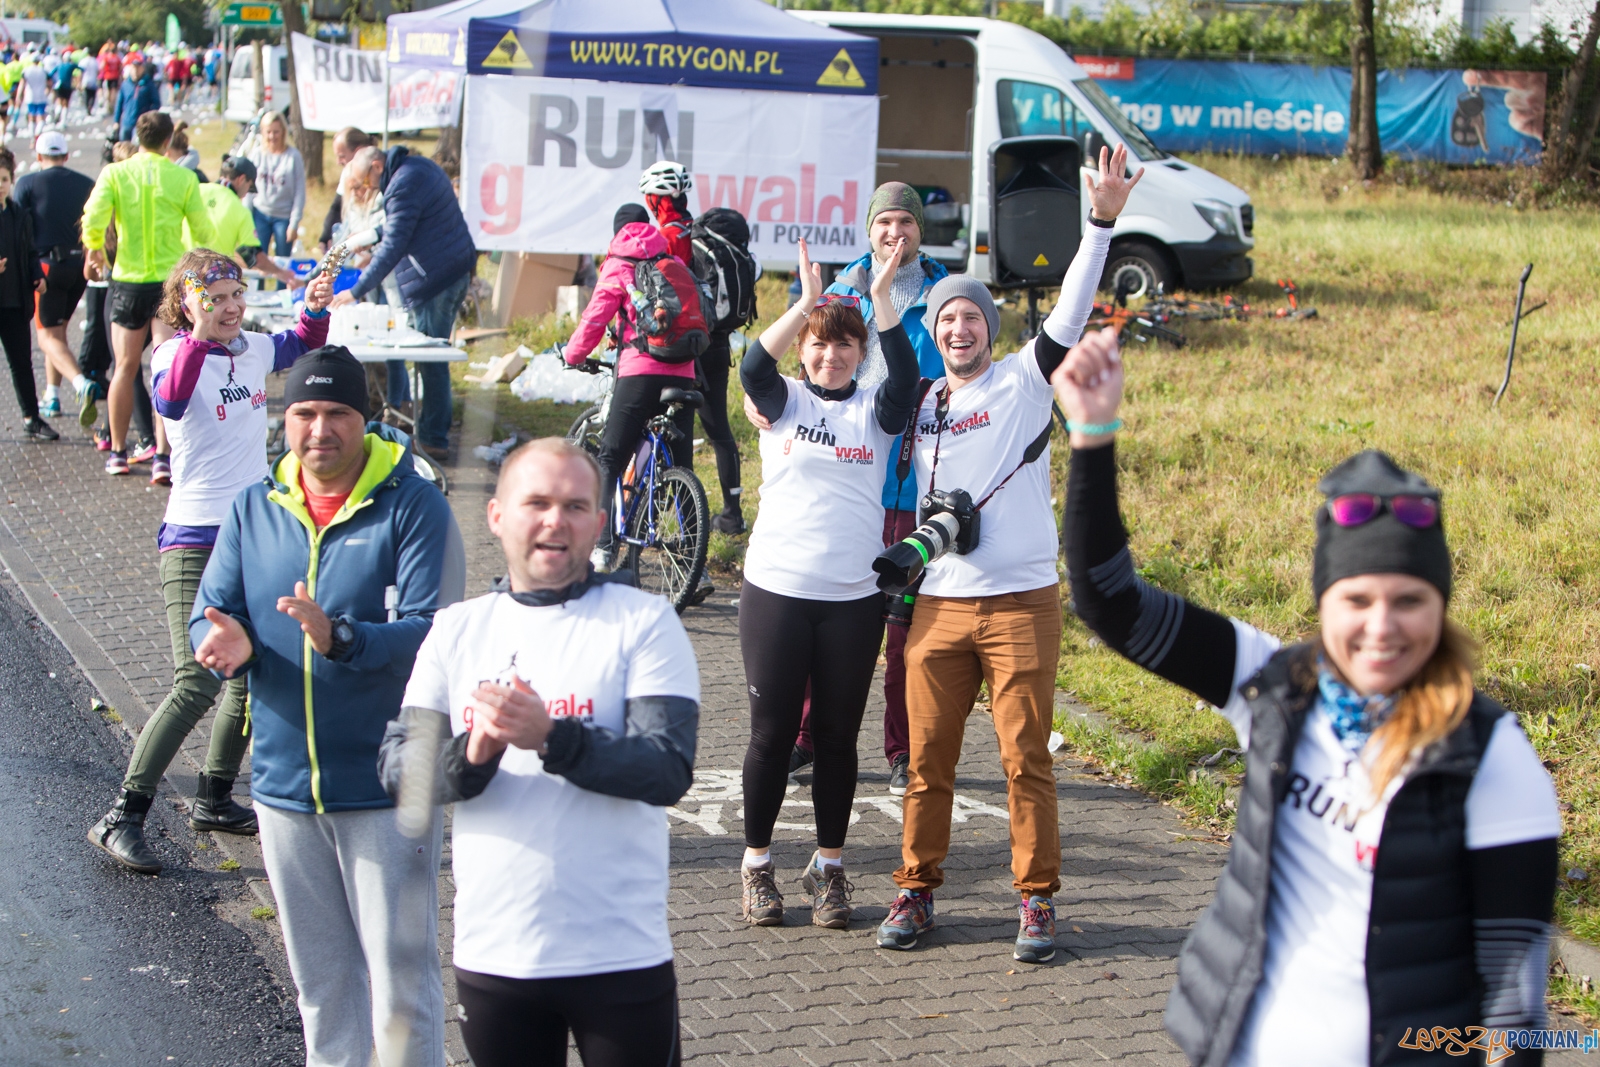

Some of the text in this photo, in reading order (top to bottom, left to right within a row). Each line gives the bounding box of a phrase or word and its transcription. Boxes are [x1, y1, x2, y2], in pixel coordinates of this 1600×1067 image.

[312, 44, 383, 83] RUN
[570, 40, 784, 75] WWW.TRYGON.PL
[1170, 104, 1203, 127] w
[1210, 101, 1345, 133] mieście
[479, 93, 859, 236] g RUN wald
[219, 385, 251, 404] RUN
[216, 403, 227, 421] g
[950, 411, 989, 433] wald
[783, 424, 874, 460] g RUN wald
[953, 428, 968, 437] TEAM
[902, 440, 911, 462] EOS
[1281, 772, 1362, 834] RUN
